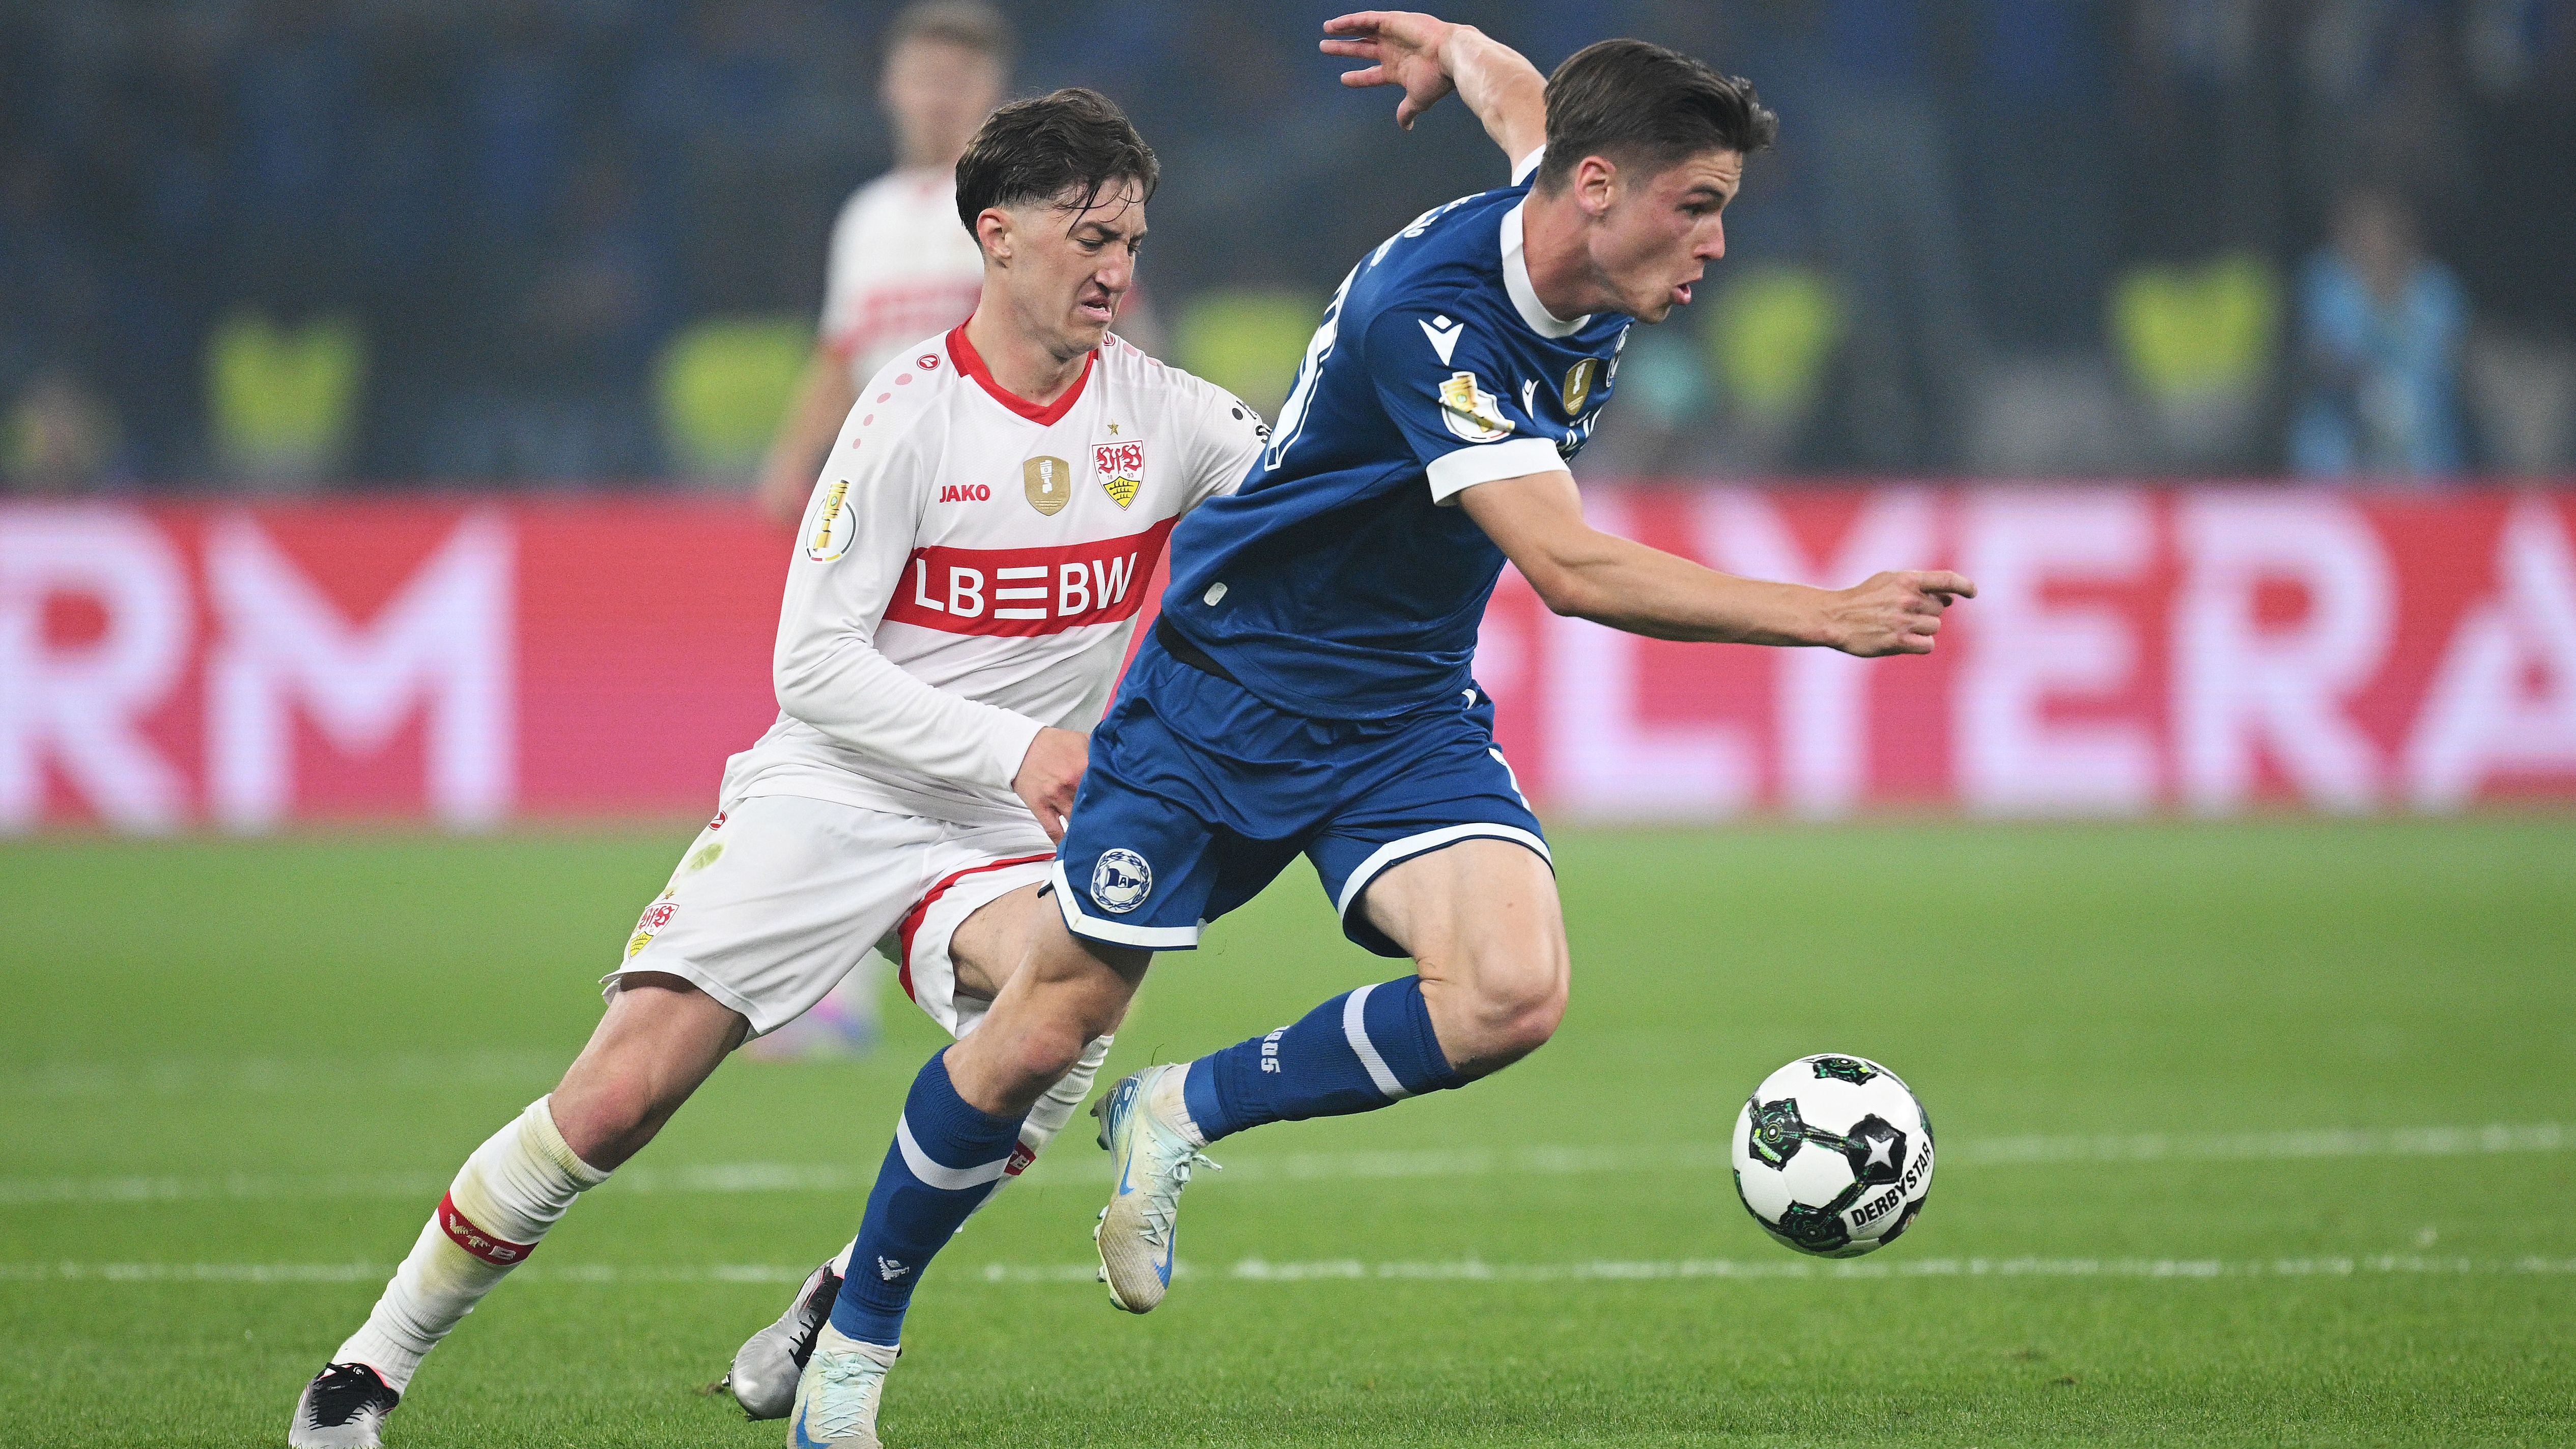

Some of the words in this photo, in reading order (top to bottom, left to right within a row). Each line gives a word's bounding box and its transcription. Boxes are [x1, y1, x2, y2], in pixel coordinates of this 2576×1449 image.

[940, 484, 990, 503] JAKO
[1119, 876, 1127, 886] A
[1850, 1142, 1932, 1227] DERBYSTAR
